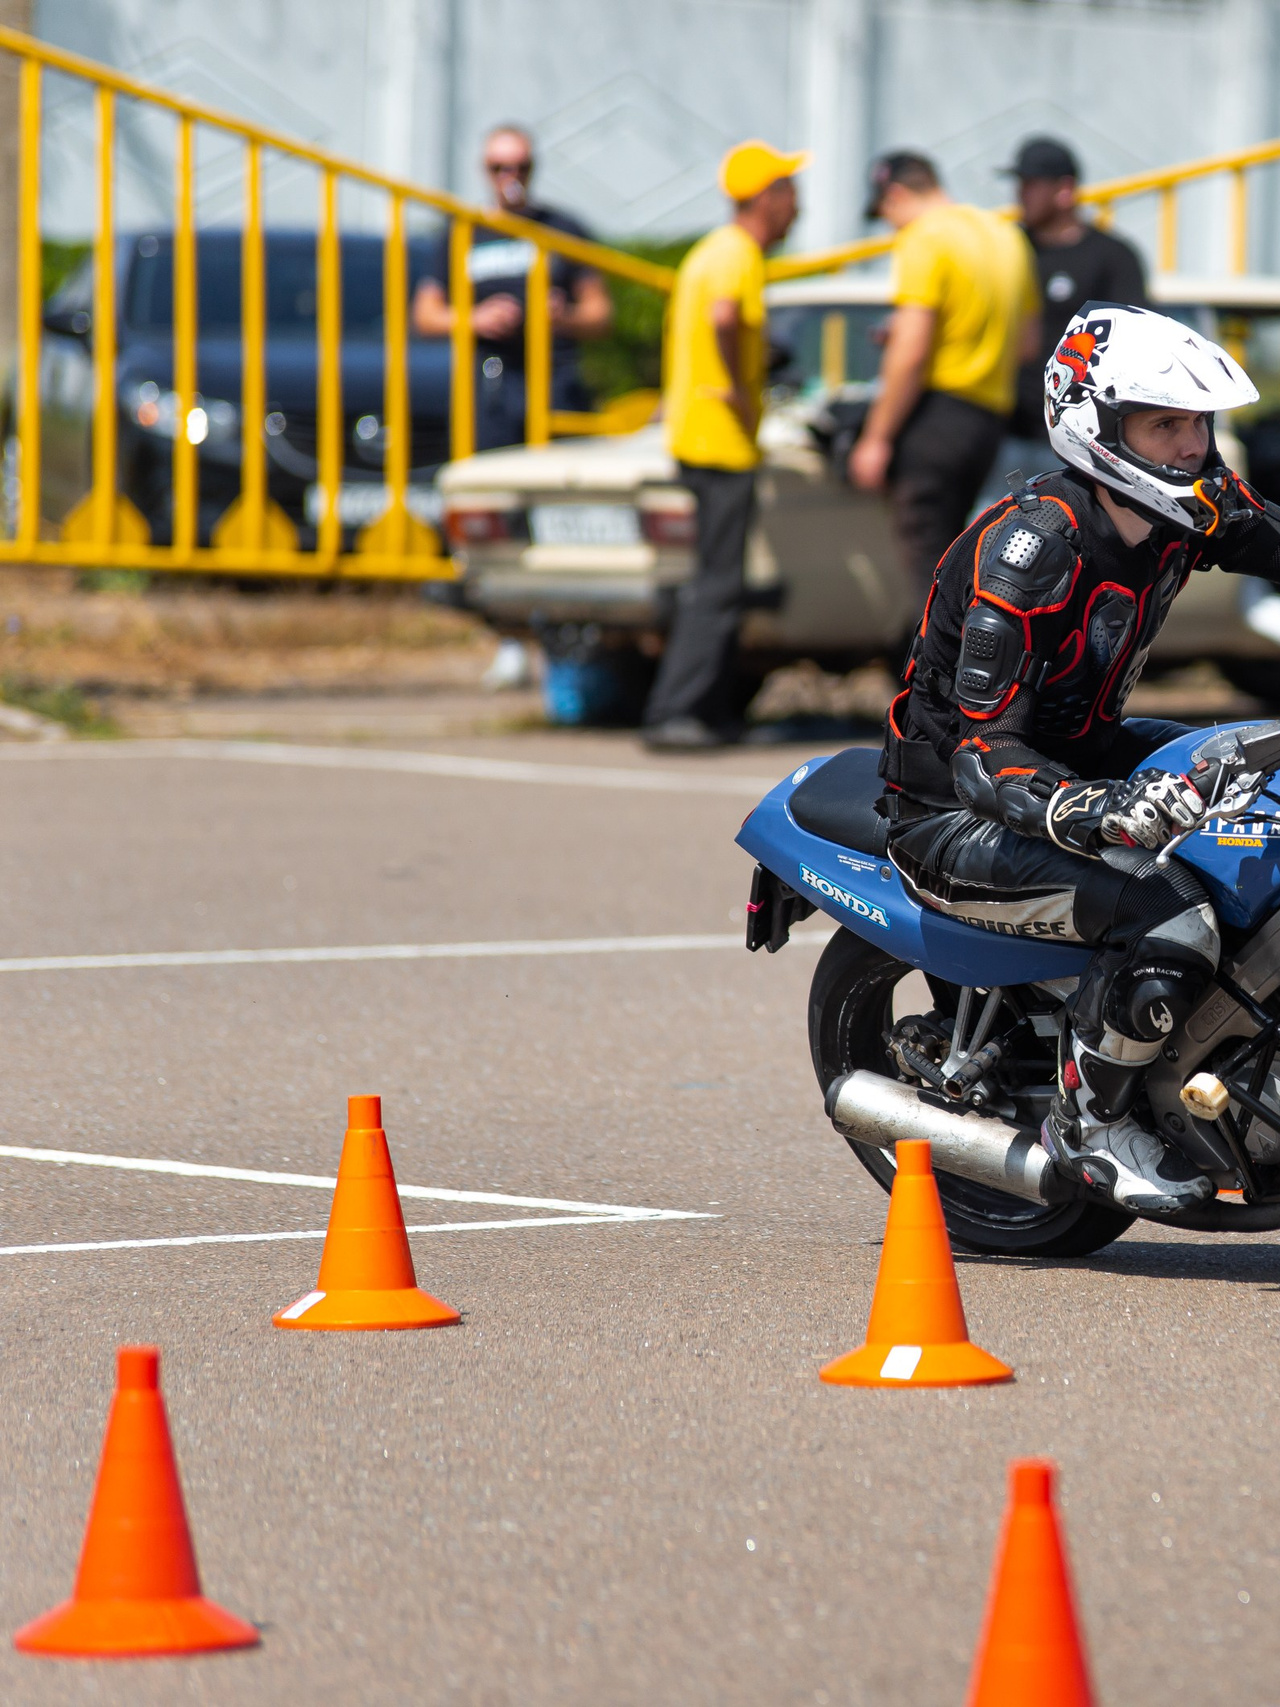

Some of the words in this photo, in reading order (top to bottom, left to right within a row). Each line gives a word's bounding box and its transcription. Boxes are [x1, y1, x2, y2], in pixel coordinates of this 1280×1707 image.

[1217, 837, 1263, 847] HONDA
[801, 867, 888, 928] HONDA
[1132, 967, 1155, 977] KOMNE
[1156, 967, 1183, 978] RACING
